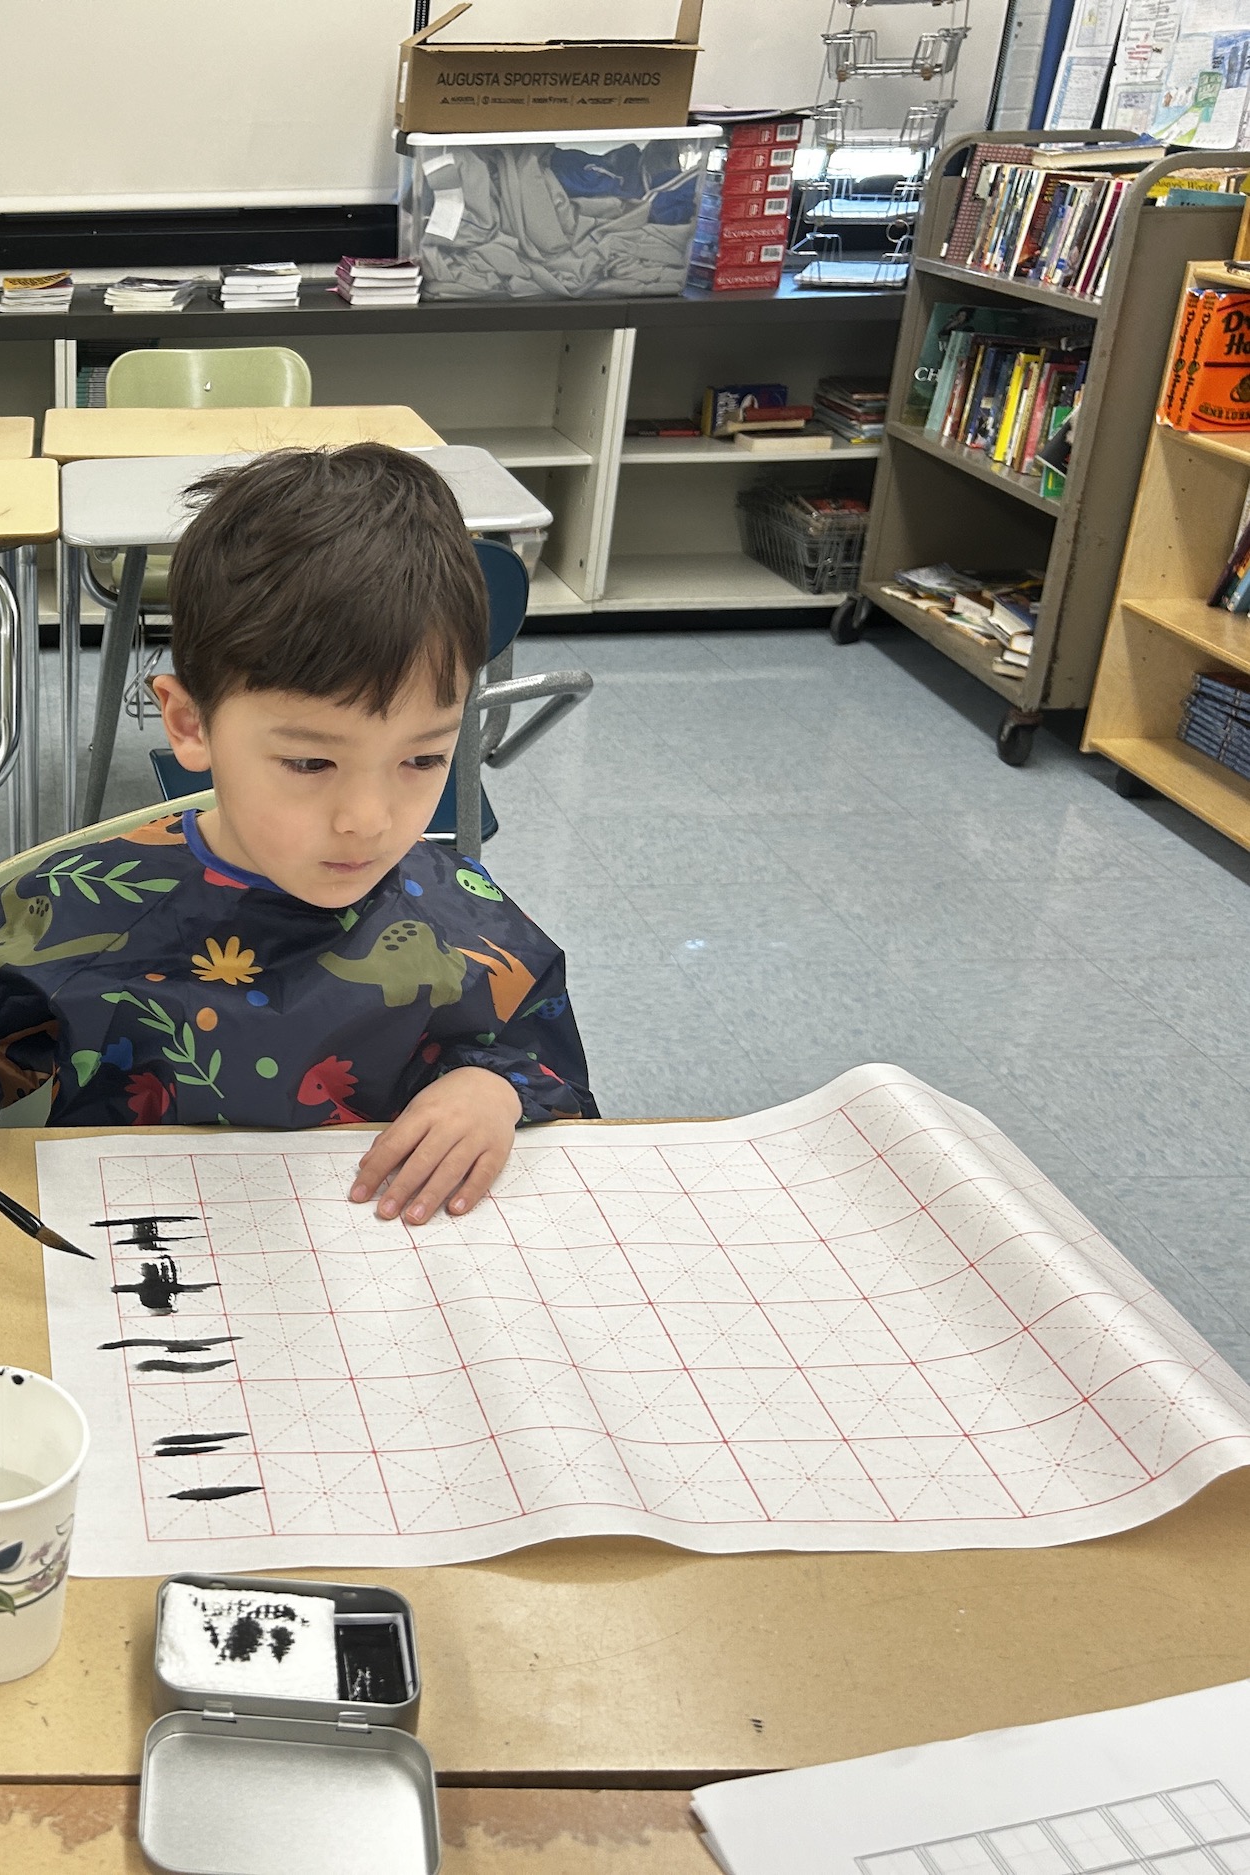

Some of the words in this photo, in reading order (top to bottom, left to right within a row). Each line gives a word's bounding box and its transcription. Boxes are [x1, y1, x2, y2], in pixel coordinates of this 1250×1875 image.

[436, 72, 500, 86] AUGUSTA
[503, 72, 600, 86] SPORTSWEAR
[603, 72, 661, 86] BRANDS
